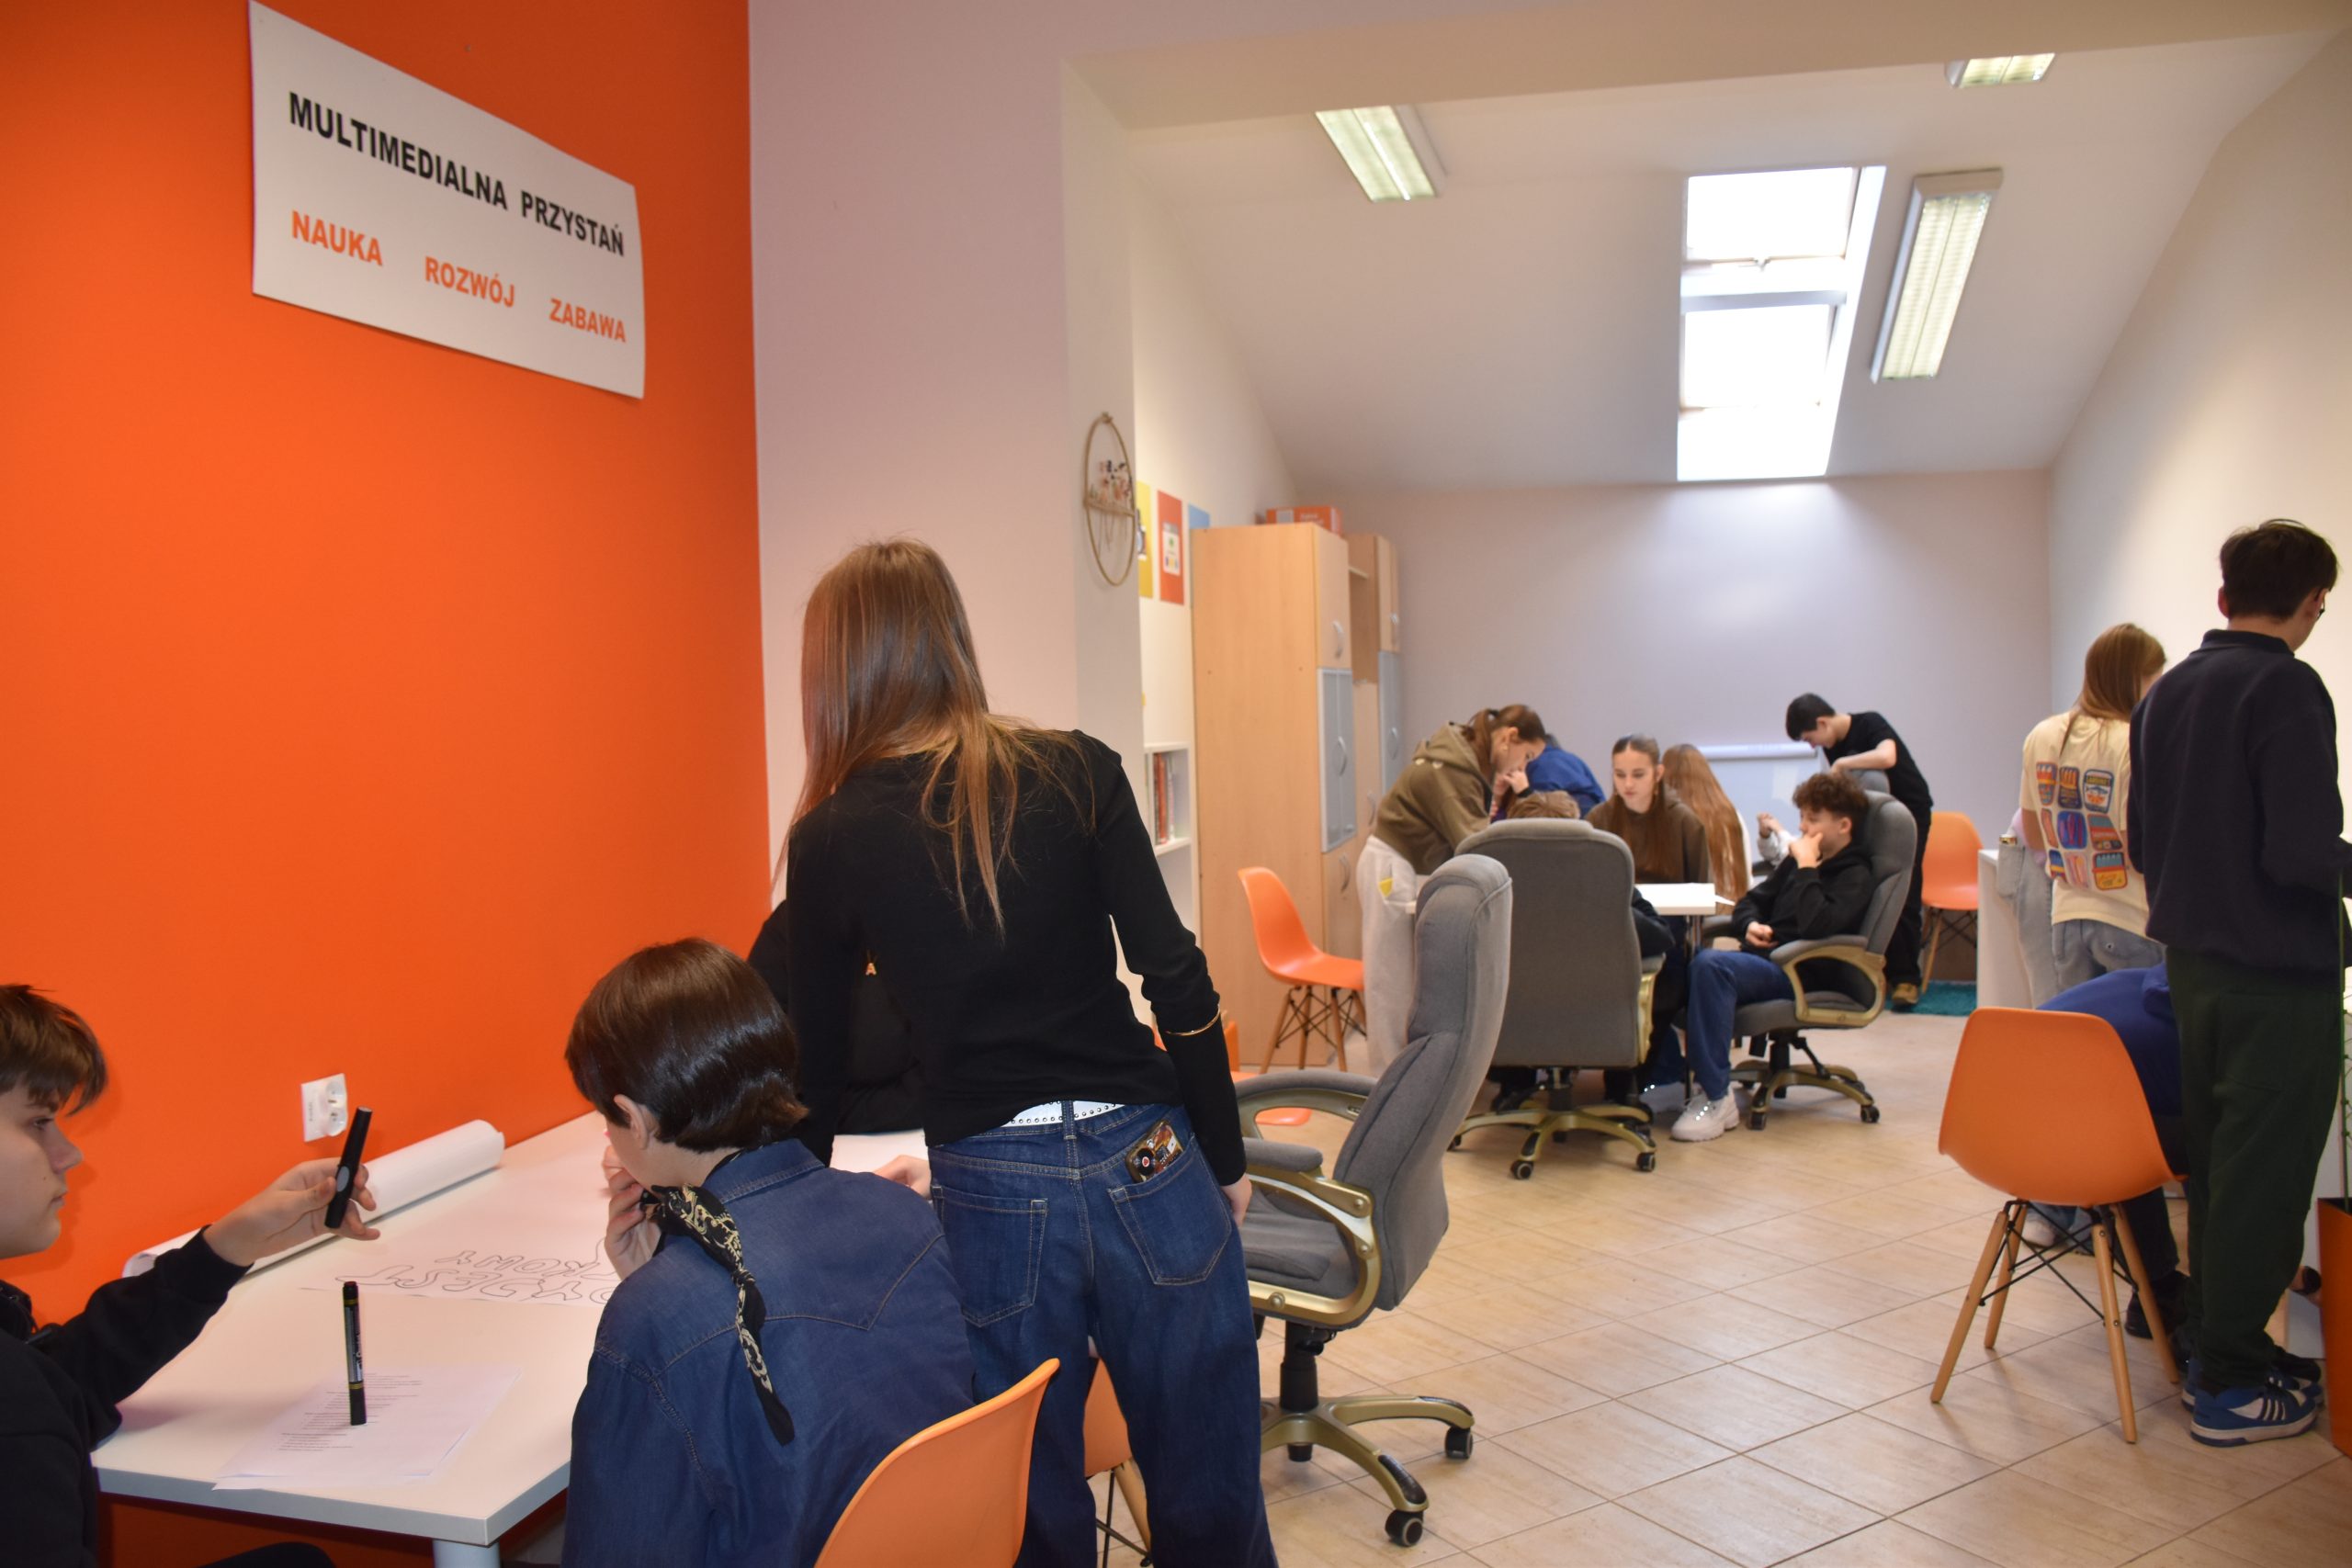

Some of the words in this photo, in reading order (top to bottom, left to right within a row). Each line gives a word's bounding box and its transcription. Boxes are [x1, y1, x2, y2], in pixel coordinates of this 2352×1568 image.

[289, 92, 508, 210] MULTIMEDIALNA
[521, 190, 625, 257] PRZYSTAŃ
[291, 210, 383, 266] NAUKA
[424, 255, 516, 308] ROZWÓJ
[549, 298, 627, 344] ZABAWA
